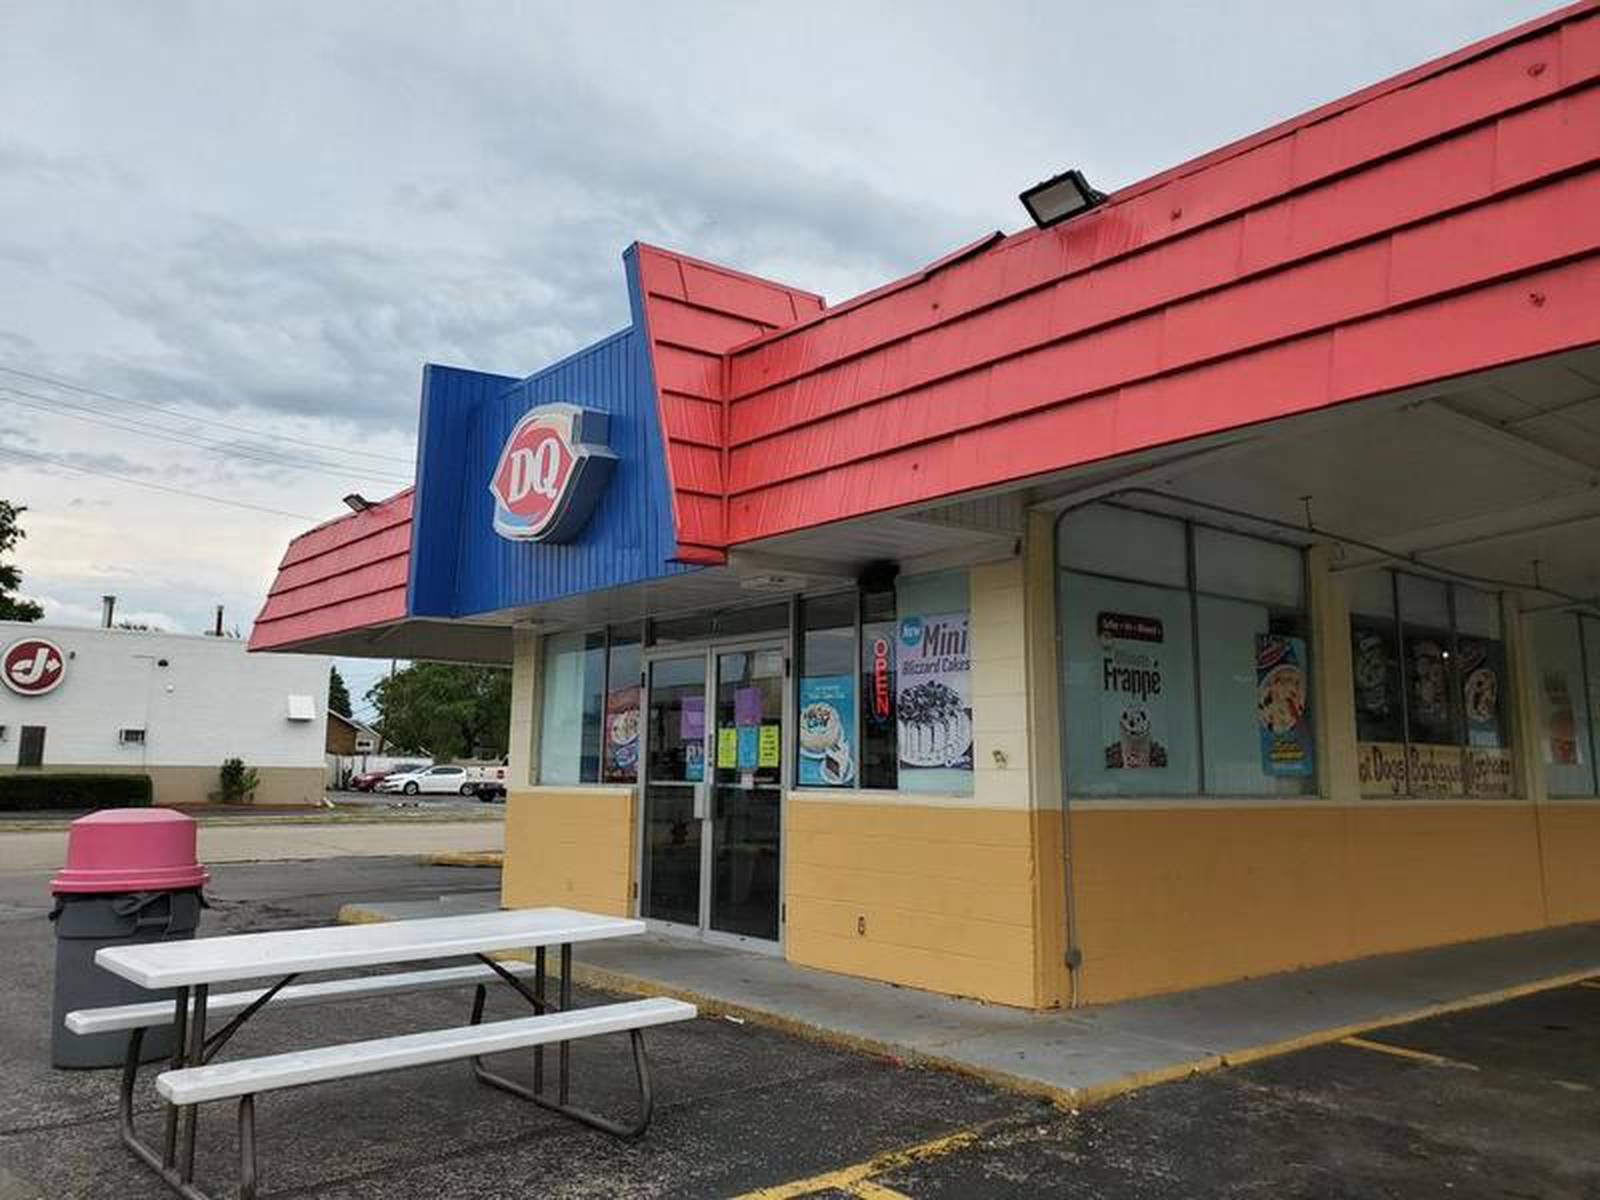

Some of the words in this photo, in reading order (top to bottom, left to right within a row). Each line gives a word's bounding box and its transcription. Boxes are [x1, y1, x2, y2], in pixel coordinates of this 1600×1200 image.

[507, 437, 561, 503] DQ
[923, 621, 969, 659] Mini
[873, 638, 890, 719] OPEN
[903, 657, 940, 675] Blizzard
[942, 657, 970, 673] Cakes
[1103, 658, 1161, 702] Frappé
[1372, 746, 1406, 794] Dogs
